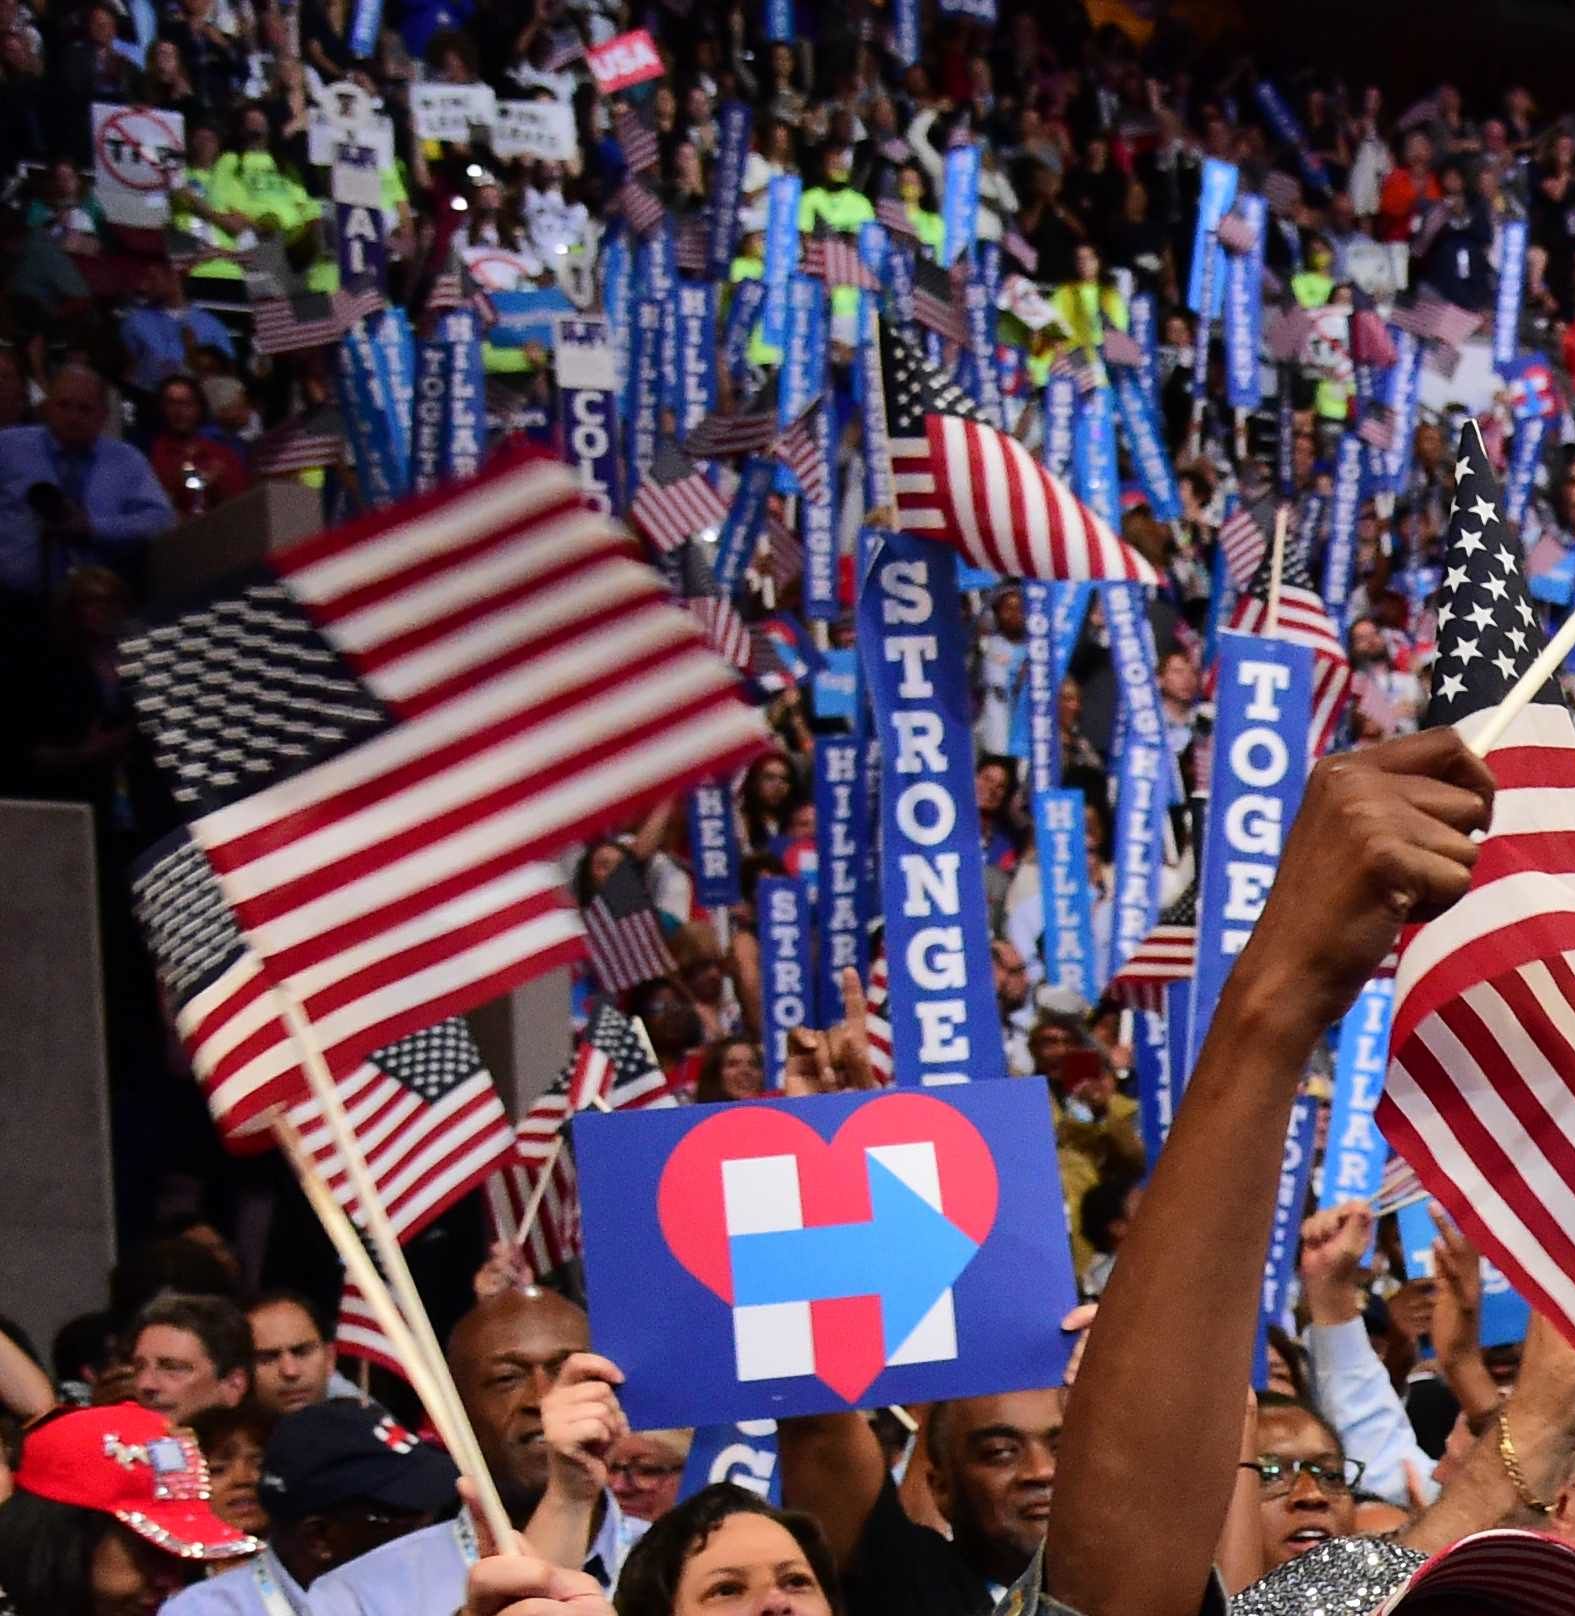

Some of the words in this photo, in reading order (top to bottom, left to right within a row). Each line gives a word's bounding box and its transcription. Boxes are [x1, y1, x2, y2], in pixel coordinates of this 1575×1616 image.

[600, 38, 660, 84] USA
[881, 559, 971, 1084] STRONGE
[1336, 979, 1394, 1203] ILLAR
